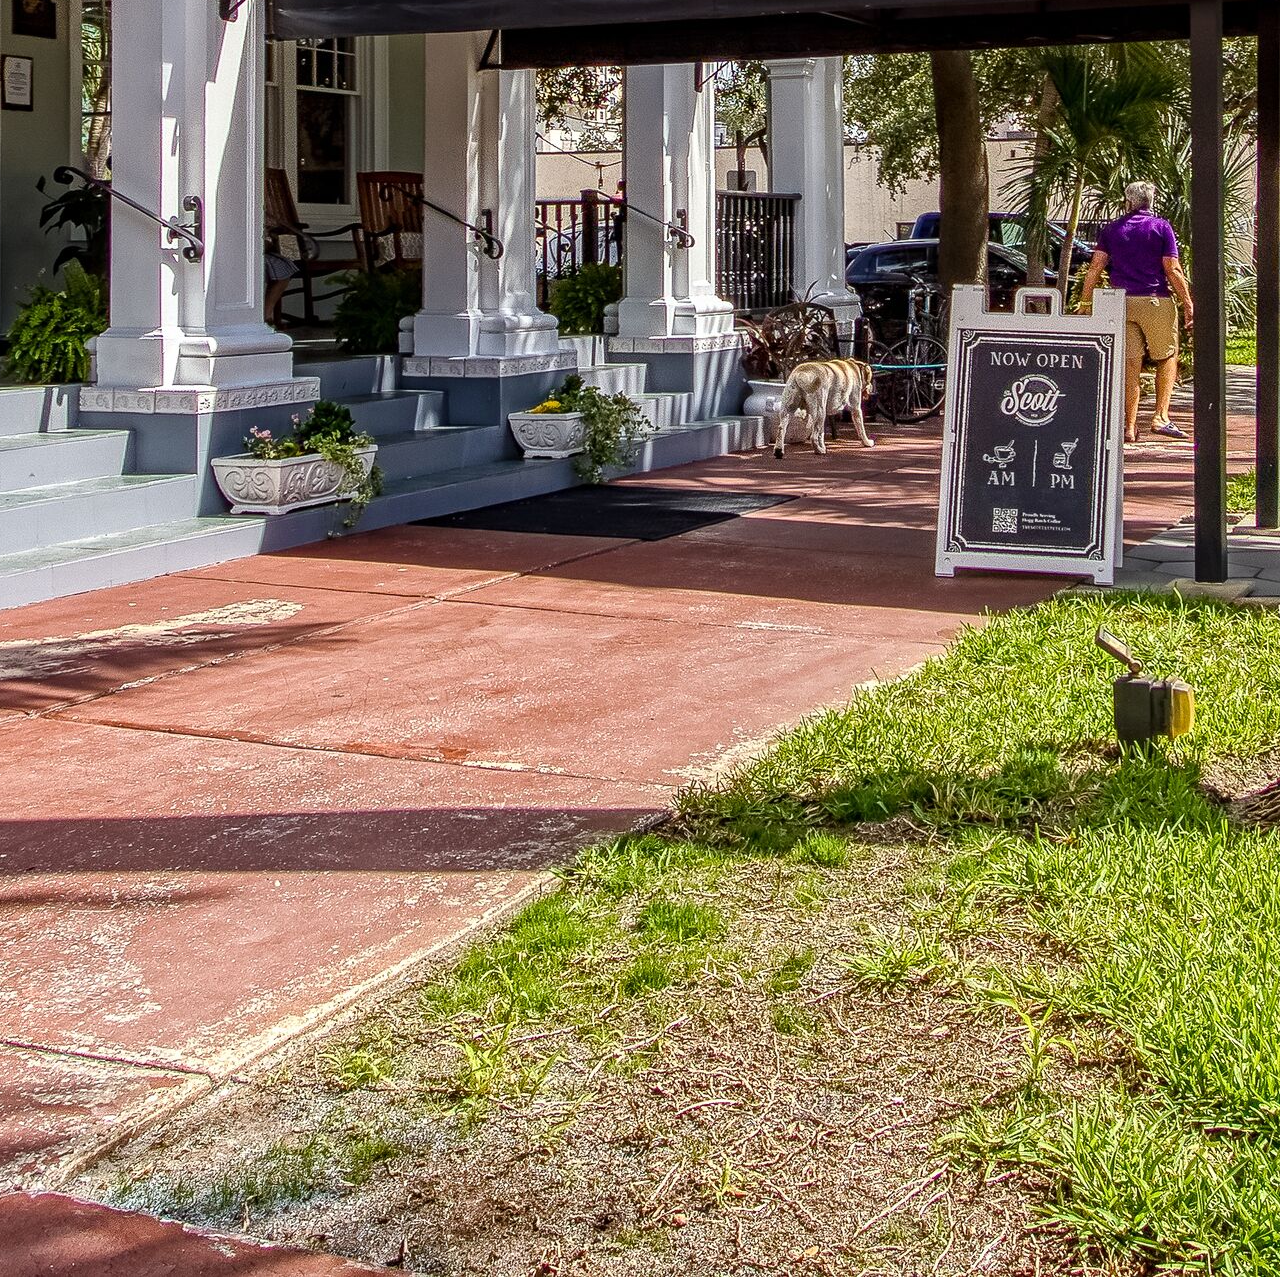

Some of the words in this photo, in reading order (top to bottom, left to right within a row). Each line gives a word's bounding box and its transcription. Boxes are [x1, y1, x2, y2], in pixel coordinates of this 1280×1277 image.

[990, 351, 1031, 367] NOW
[1037, 353, 1084, 369] OPEN
[1001, 378, 1067, 415] Scott
[987, 470, 1016, 486] AM
[1050, 475, 1075, 489] PM
